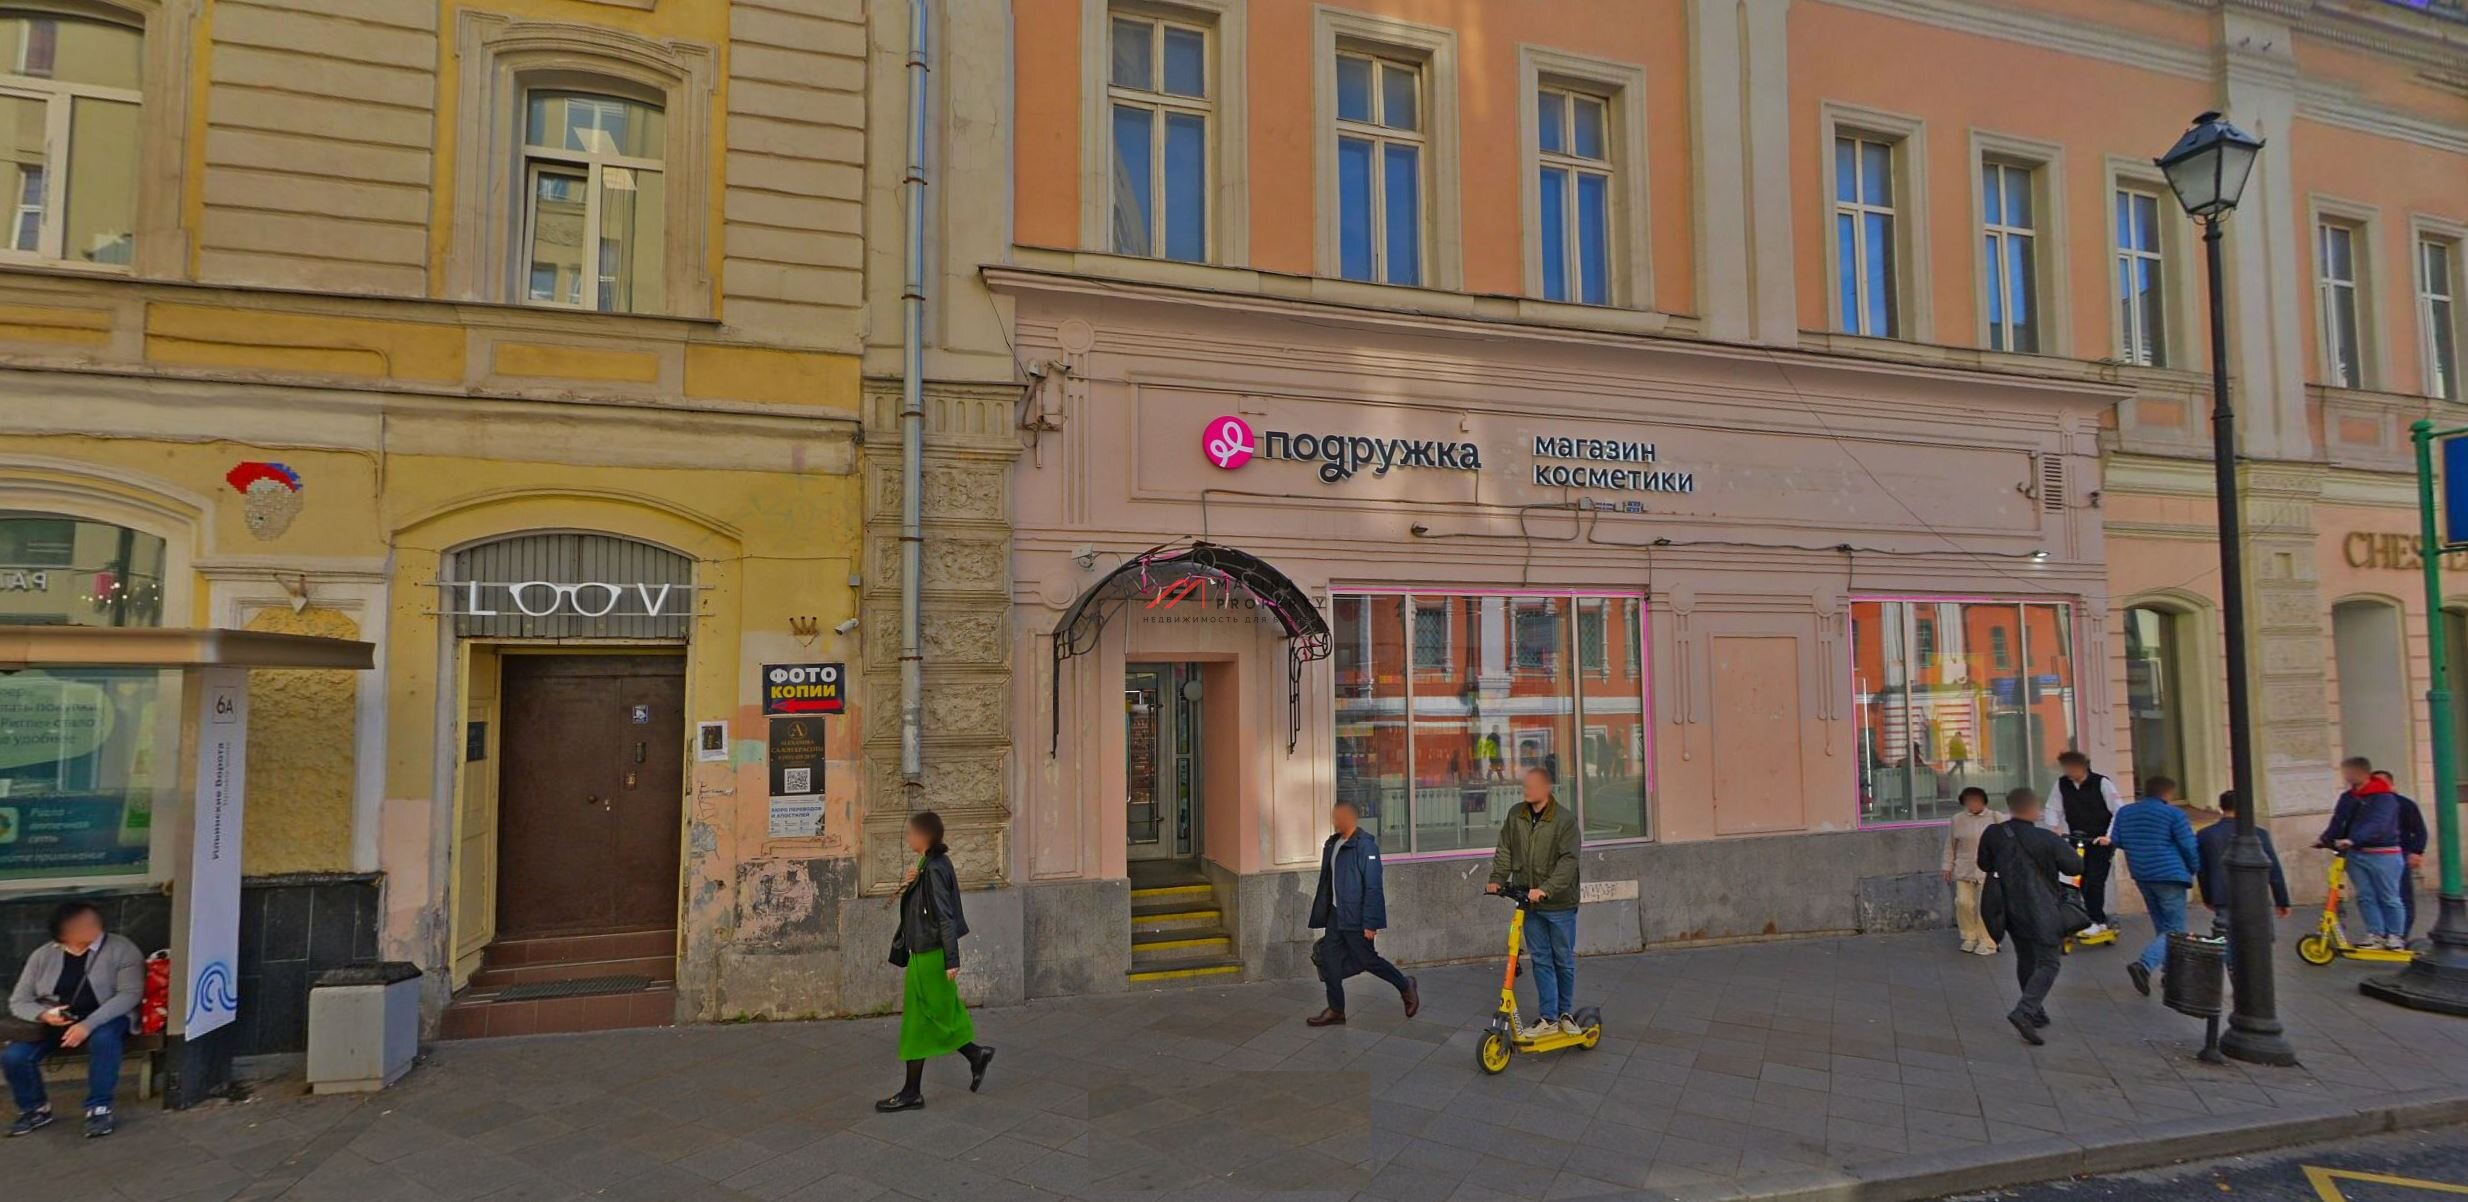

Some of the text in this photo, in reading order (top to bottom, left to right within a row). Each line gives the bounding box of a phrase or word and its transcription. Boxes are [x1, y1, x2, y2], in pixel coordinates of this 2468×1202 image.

[1263, 430, 1482, 484] подружка
[1533, 435, 1655, 462] магазин
[1533, 464, 1693, 493] косметики
[769, 666, 837, 684] ФОТО
[771, 684, 836, 699] КОПИИ
